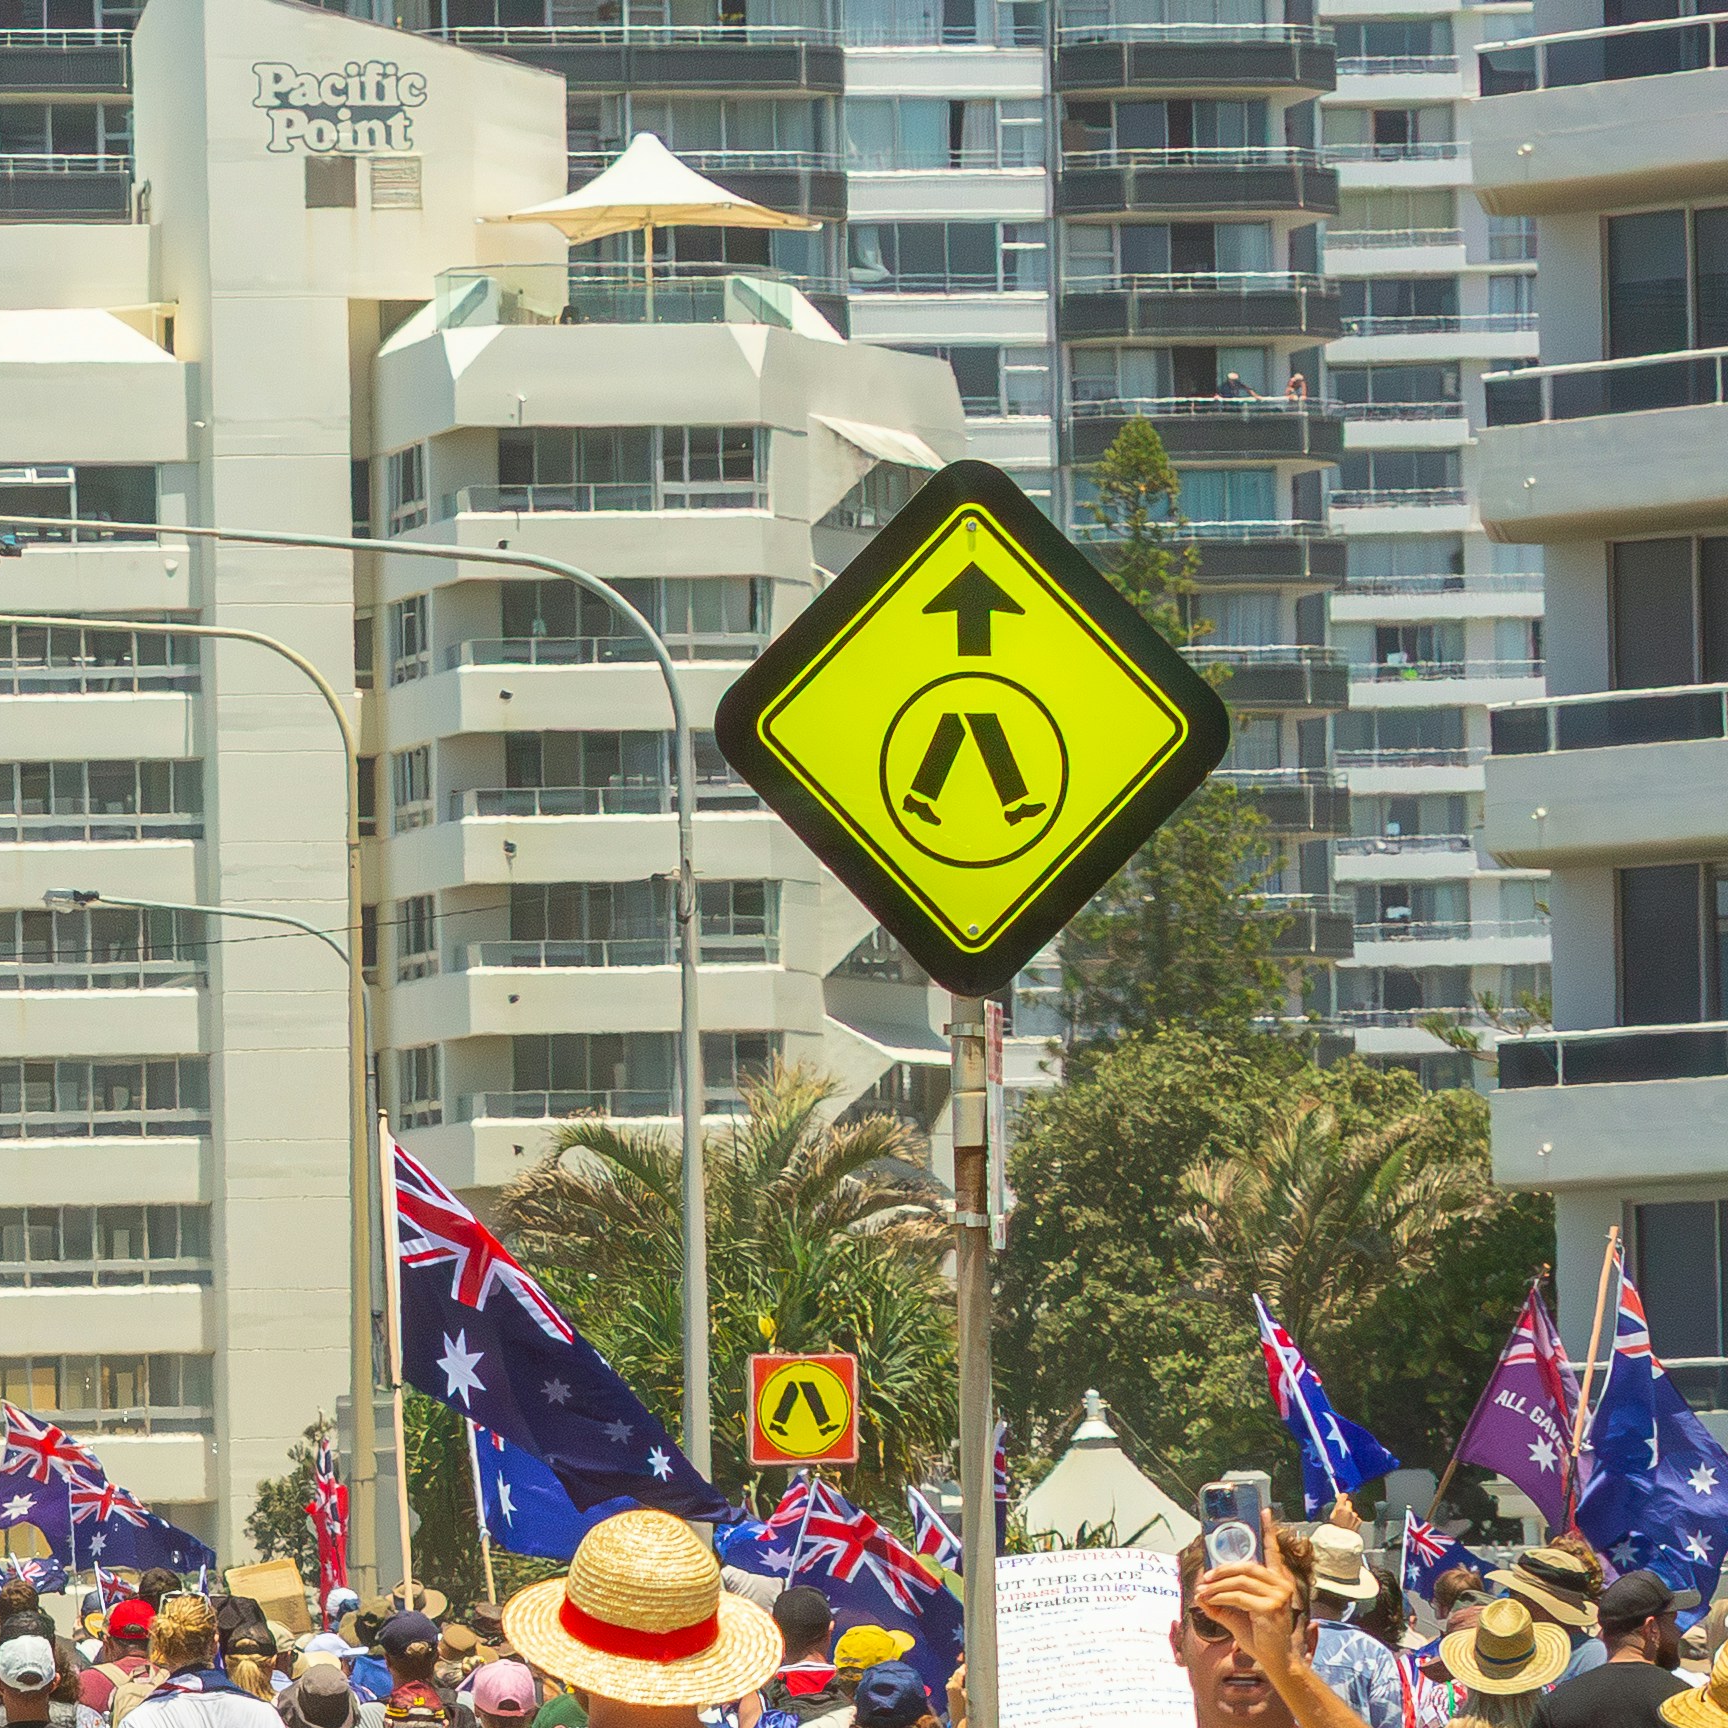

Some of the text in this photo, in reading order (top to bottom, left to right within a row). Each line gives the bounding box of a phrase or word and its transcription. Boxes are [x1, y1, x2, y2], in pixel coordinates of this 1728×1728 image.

[252, 60, 428, 108] Pacific
[266, 106, 413, 153] Point
[1495, 1389, 1527, 1415] ALL
[1040, 1550, 1161, 1565] AUSTRALIA
[1032, 1574, 1077, 1588] THE
[1082, 1570, 1143, 1583] GATE
